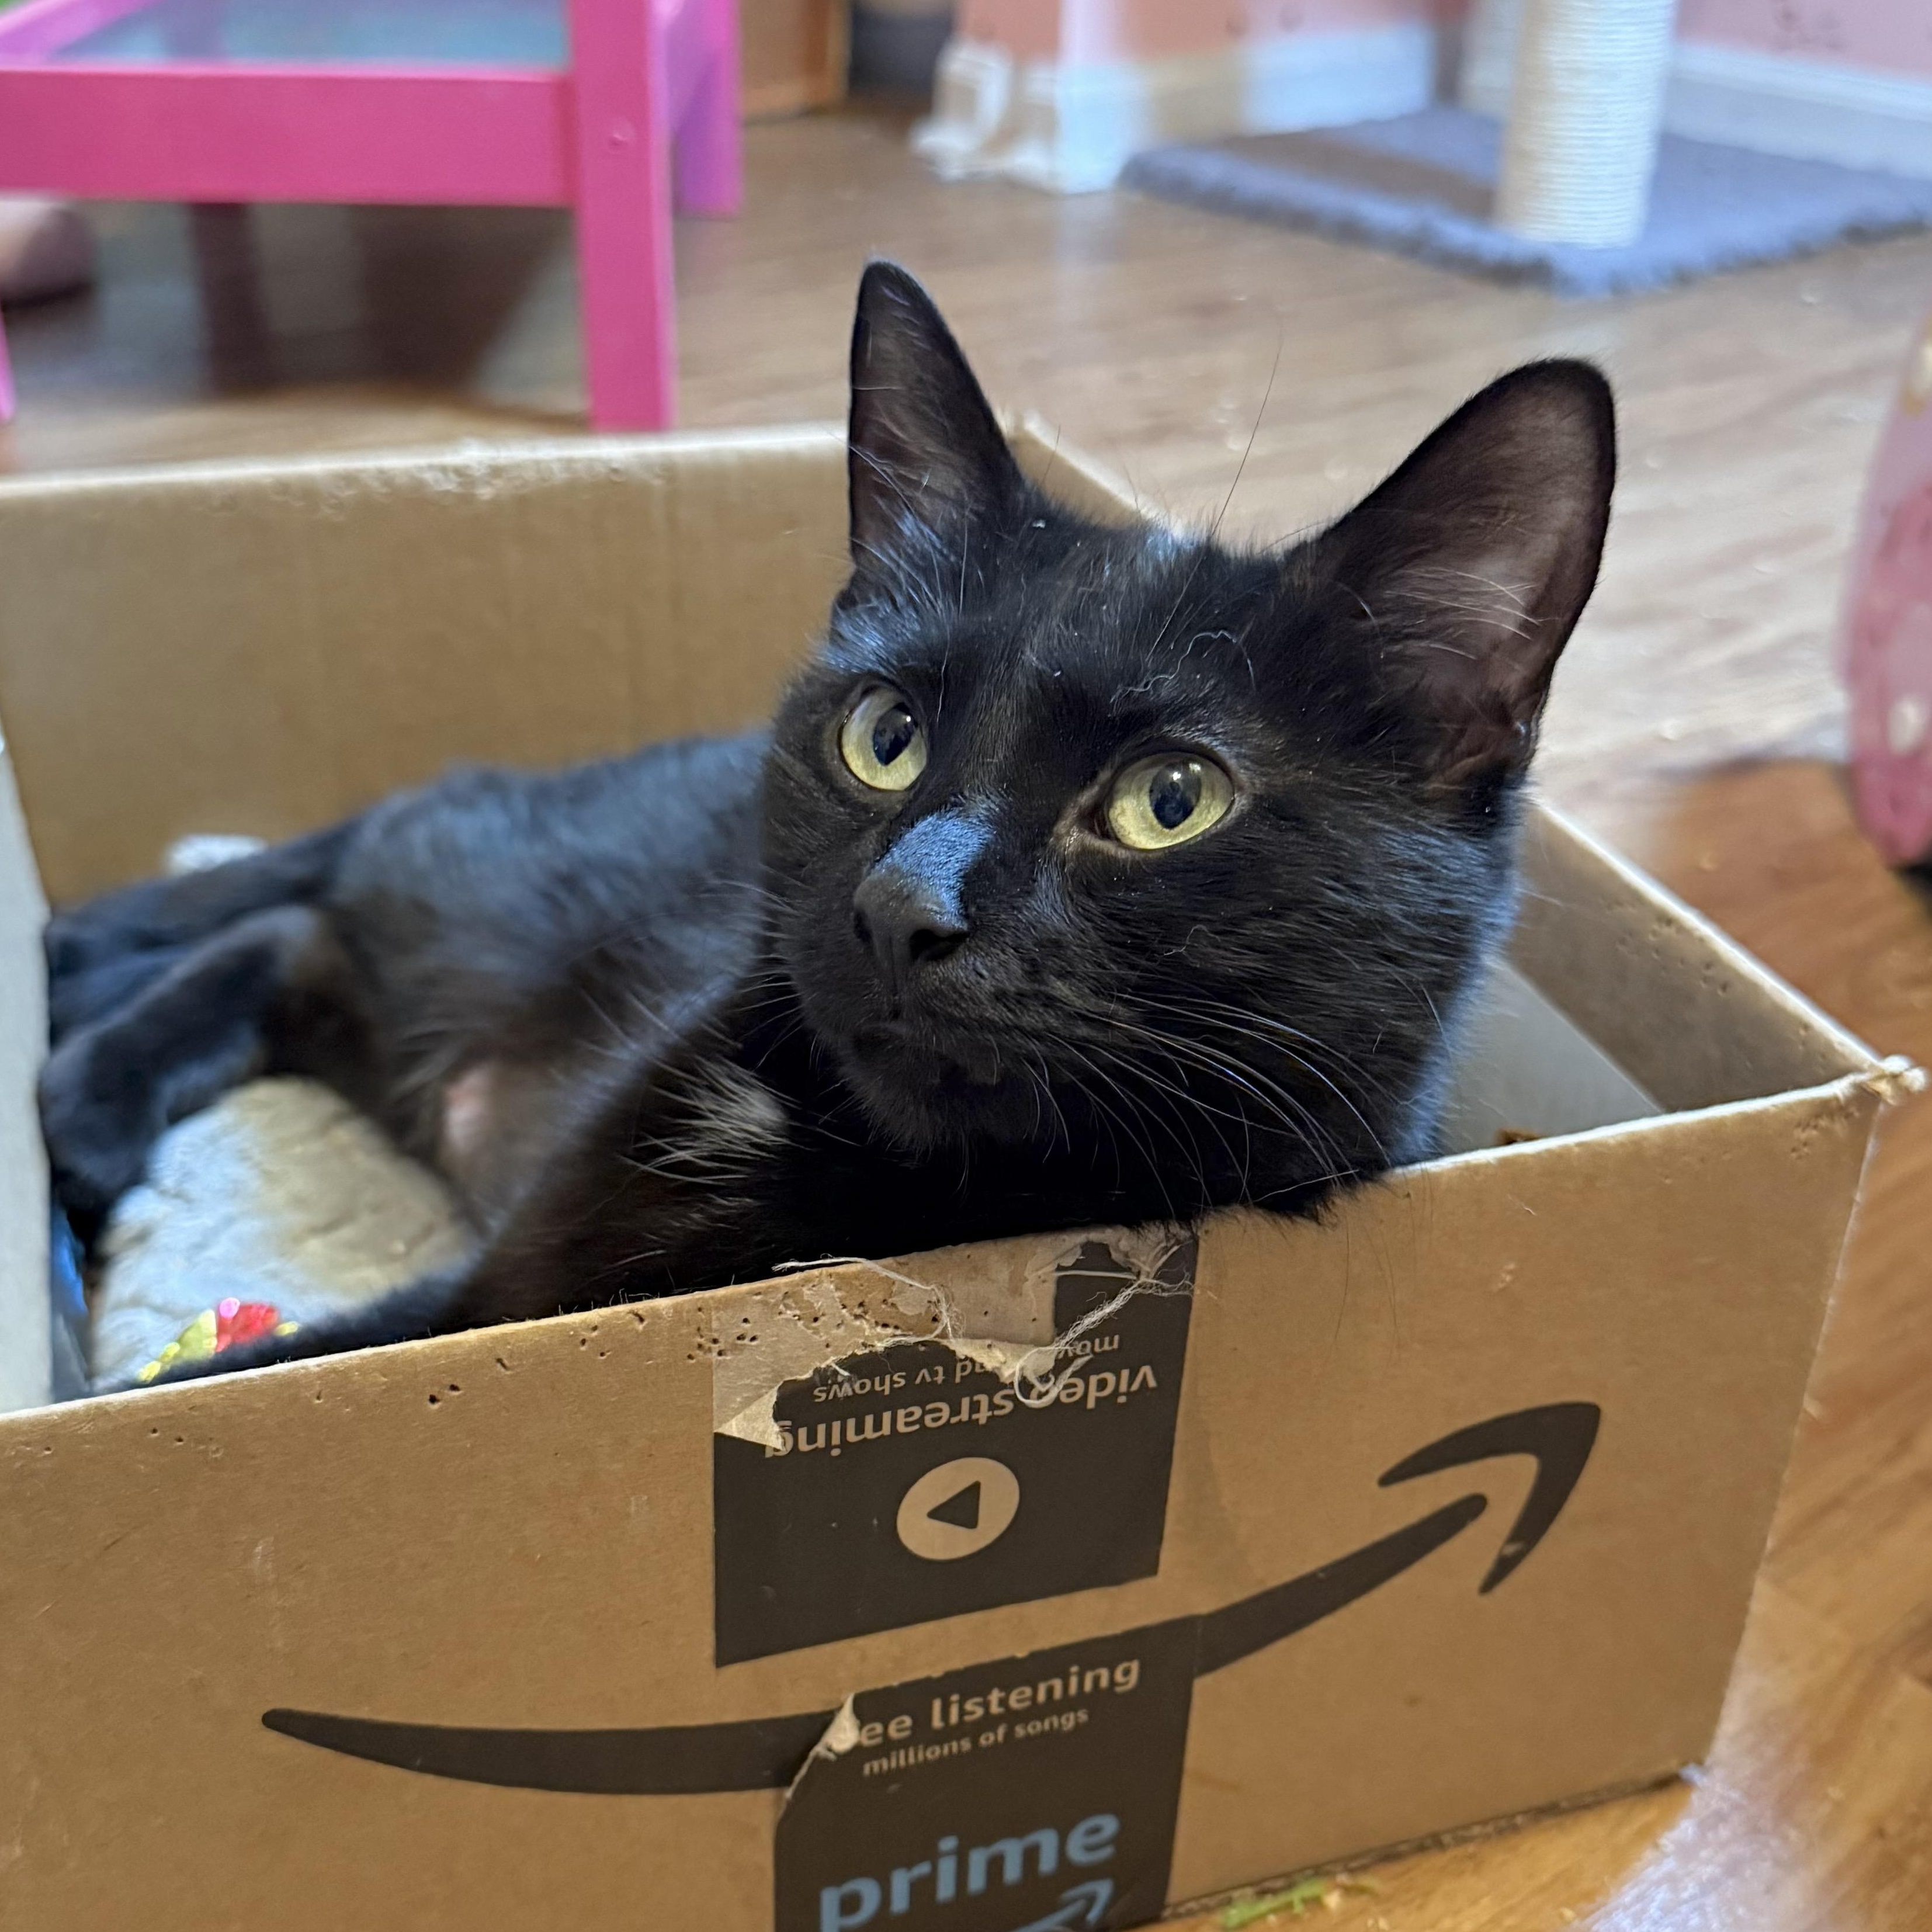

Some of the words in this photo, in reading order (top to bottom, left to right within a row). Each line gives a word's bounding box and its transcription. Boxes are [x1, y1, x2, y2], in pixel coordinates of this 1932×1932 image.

[813, 1372, 906, 1403] shows
[915, 1365, 945, 1385] tv
[764, 1388, 1015, 1459] streaming
[930, 1659, 1140, 1730] listening
[862, 1736, 972, 1777] millions
[978, 1722, 1009, 1747] of
[1014, 1708, 1089, 1739] songs
[820, 1812, 1121, 1932] prime
